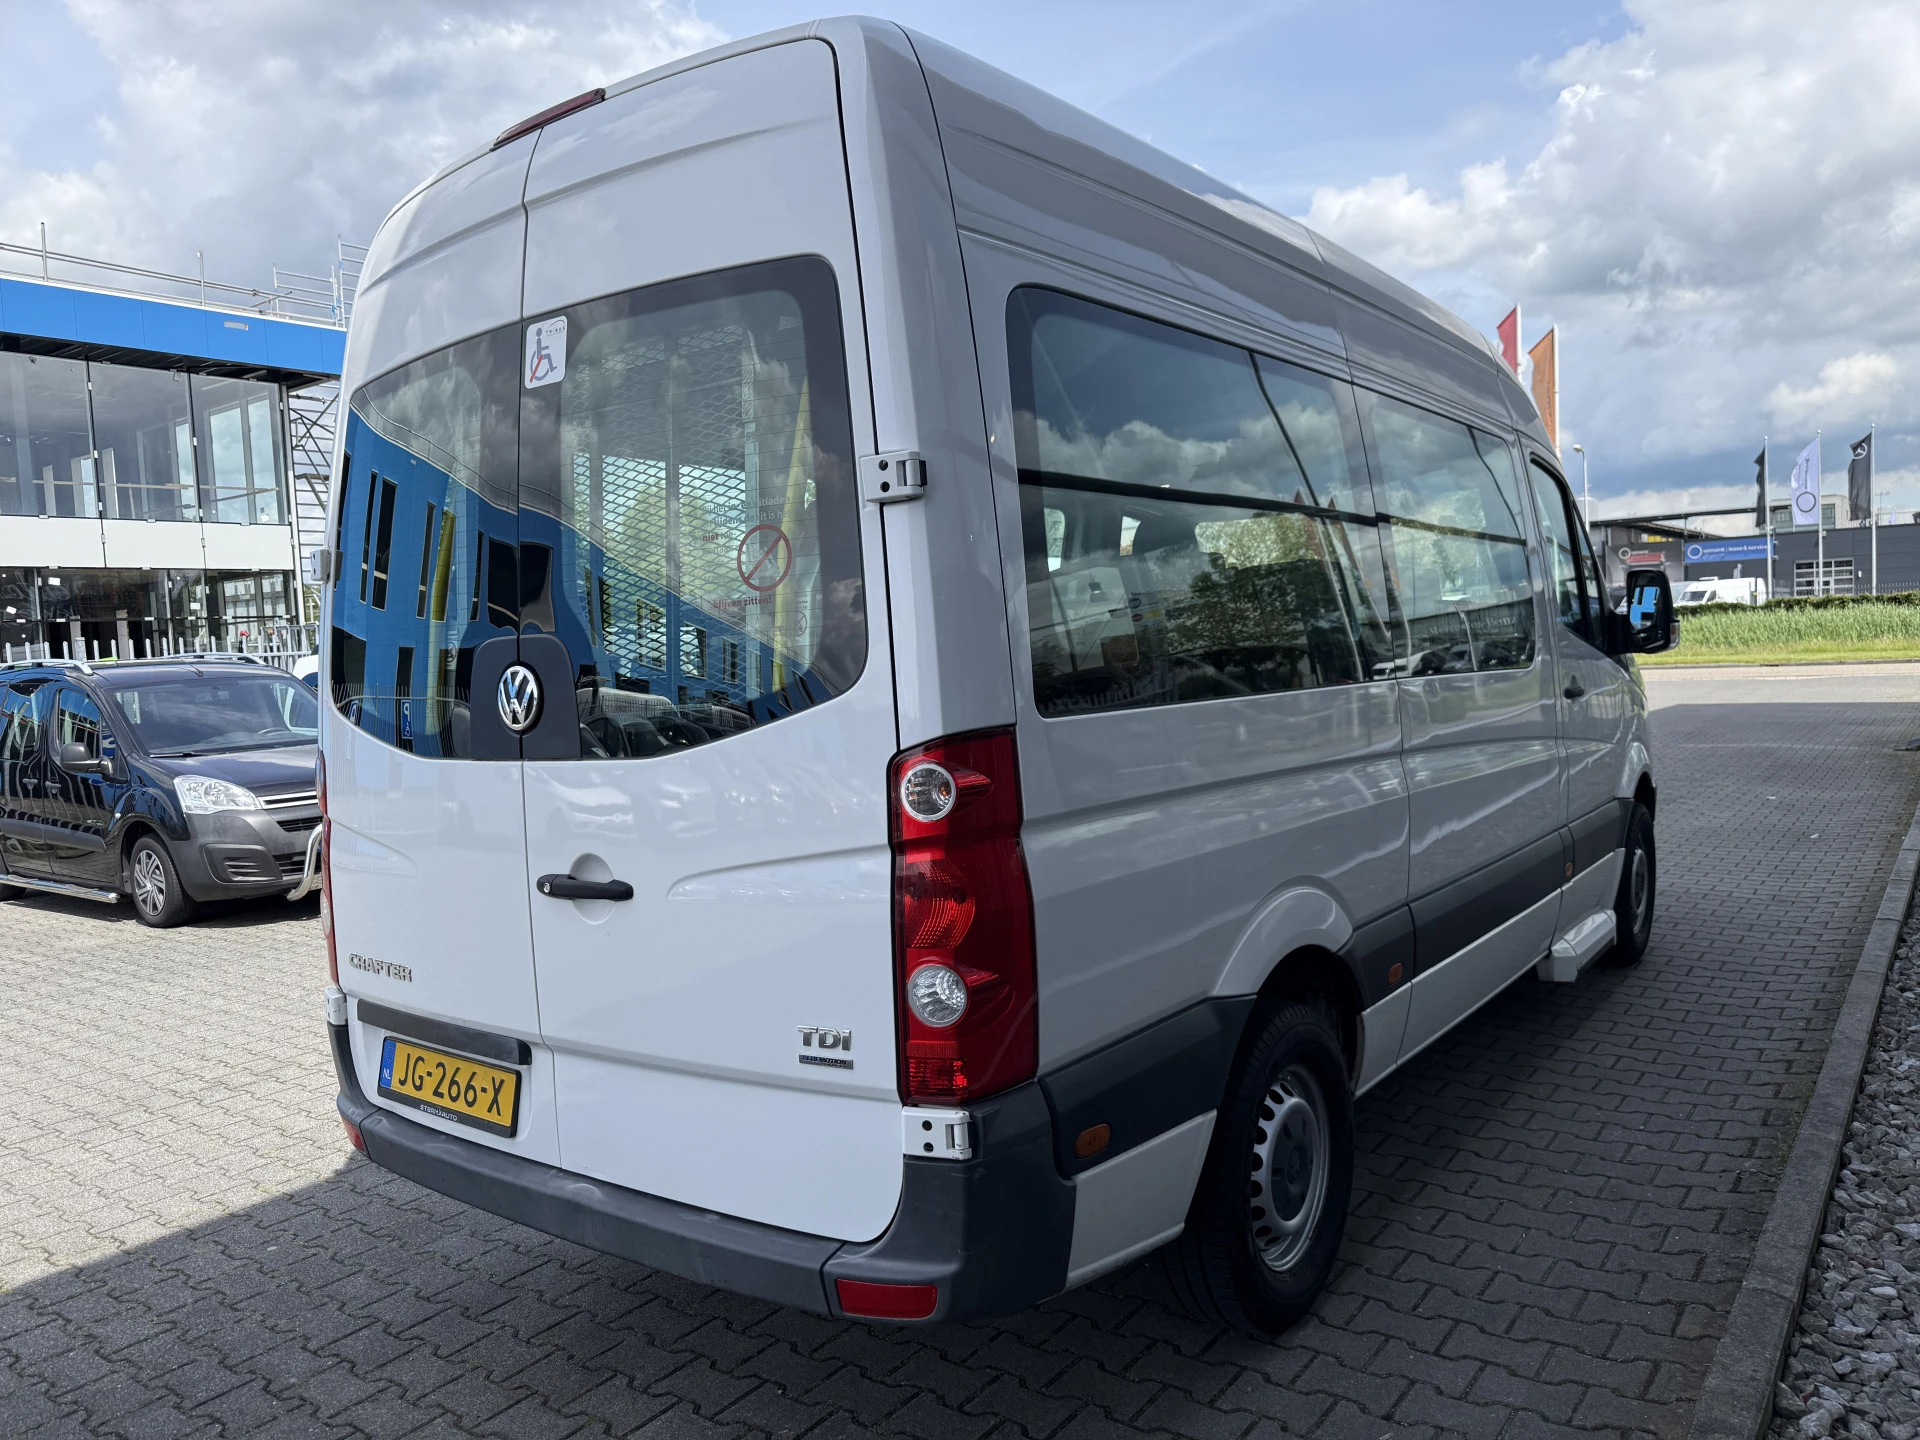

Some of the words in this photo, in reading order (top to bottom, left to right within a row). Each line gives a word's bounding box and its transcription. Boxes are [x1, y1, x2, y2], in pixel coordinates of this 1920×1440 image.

[702, 533, 719, 542] niet
[713, 599, 742, 611] blijven
[743, 595, 772, 606] zitten!
[349, 953, 412, 982] CRAFTER
[797, 1025, 851, 1051] TDI
[383, 1067, 391, 1080] NL
[398, 1052, 505, 1117] JG-266-X
